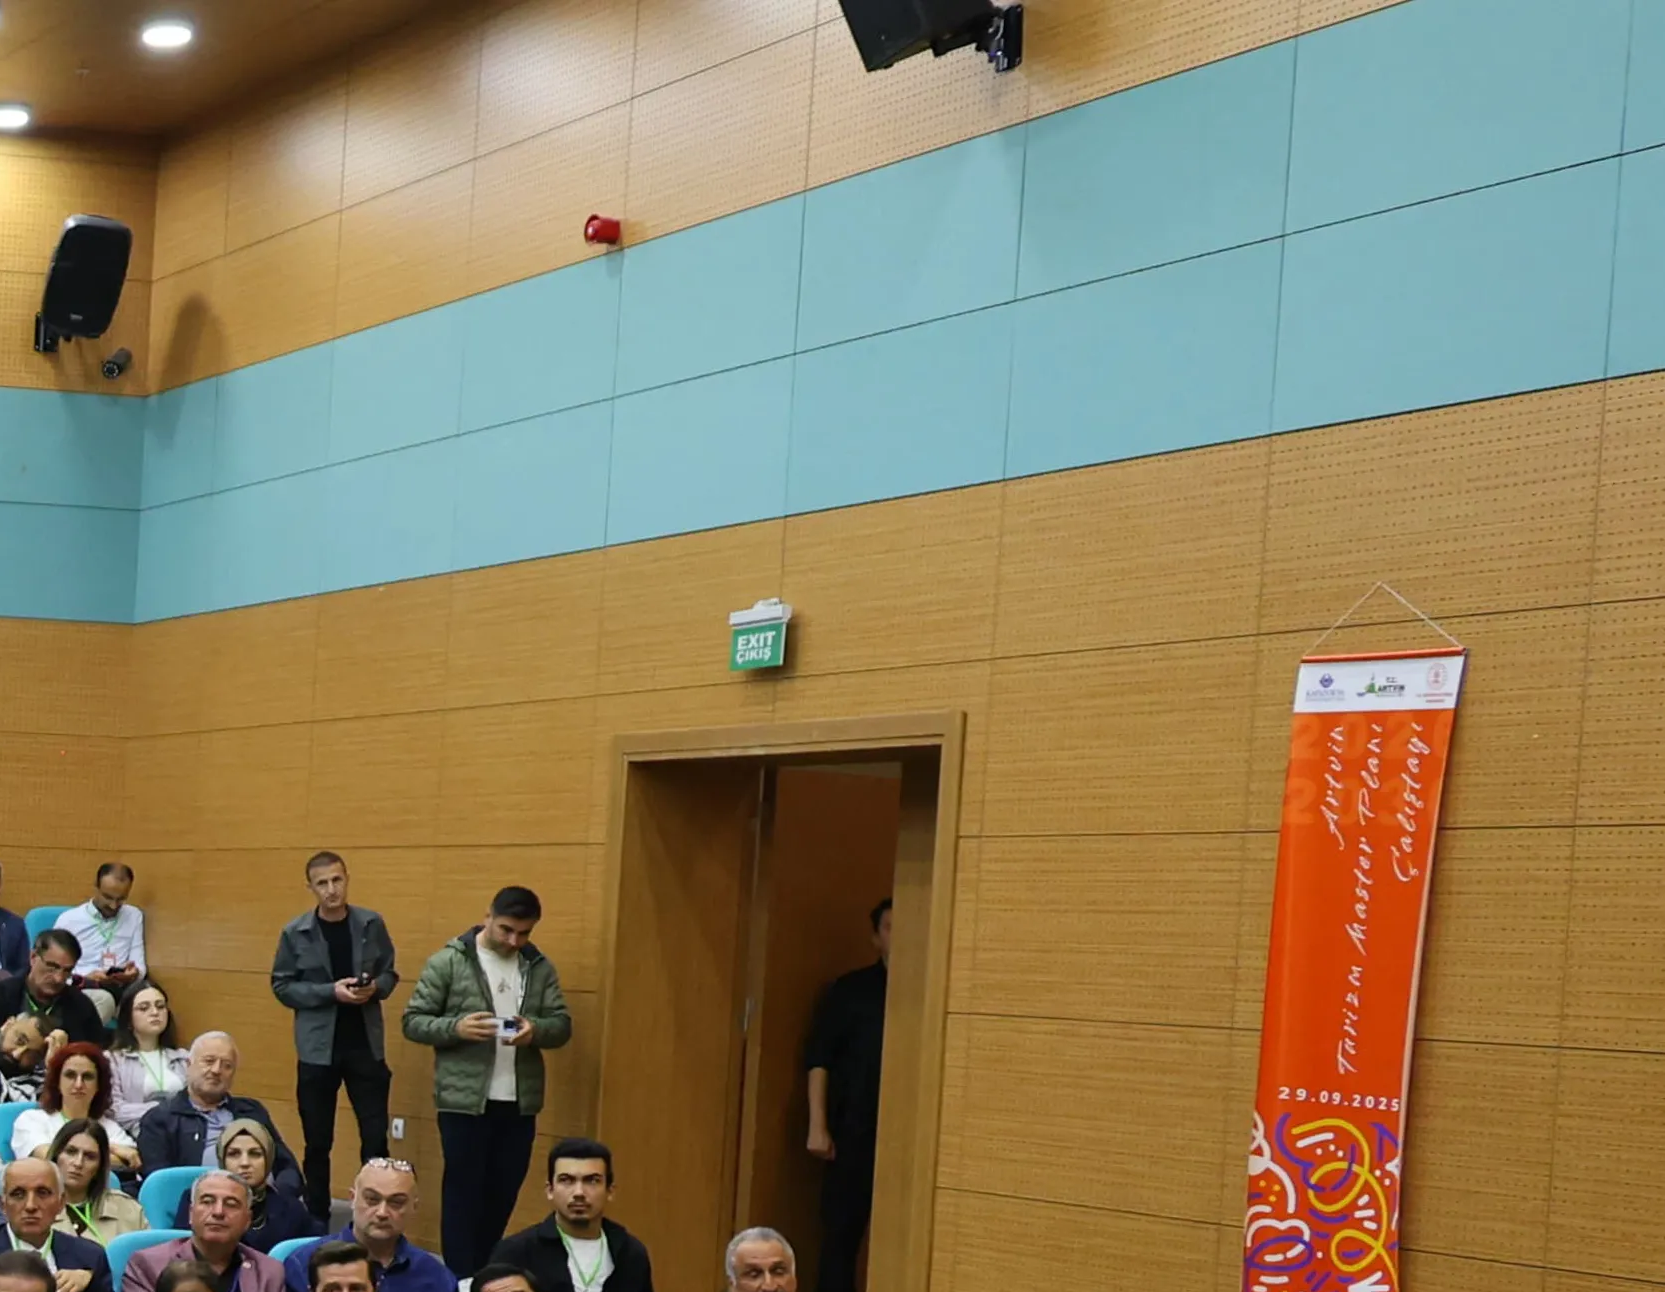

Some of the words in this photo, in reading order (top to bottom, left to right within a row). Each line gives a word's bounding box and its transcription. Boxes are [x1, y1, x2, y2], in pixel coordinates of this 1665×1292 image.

[737, 630, 776, 650] EXIT
[1320, 726, 1345, 851] Artvin
[1345, 836, 1374, 957] Master
[1337, 965, 1364, 1075] Turizm
[1277, 1086, 1401, 1112] 29.09.2025
